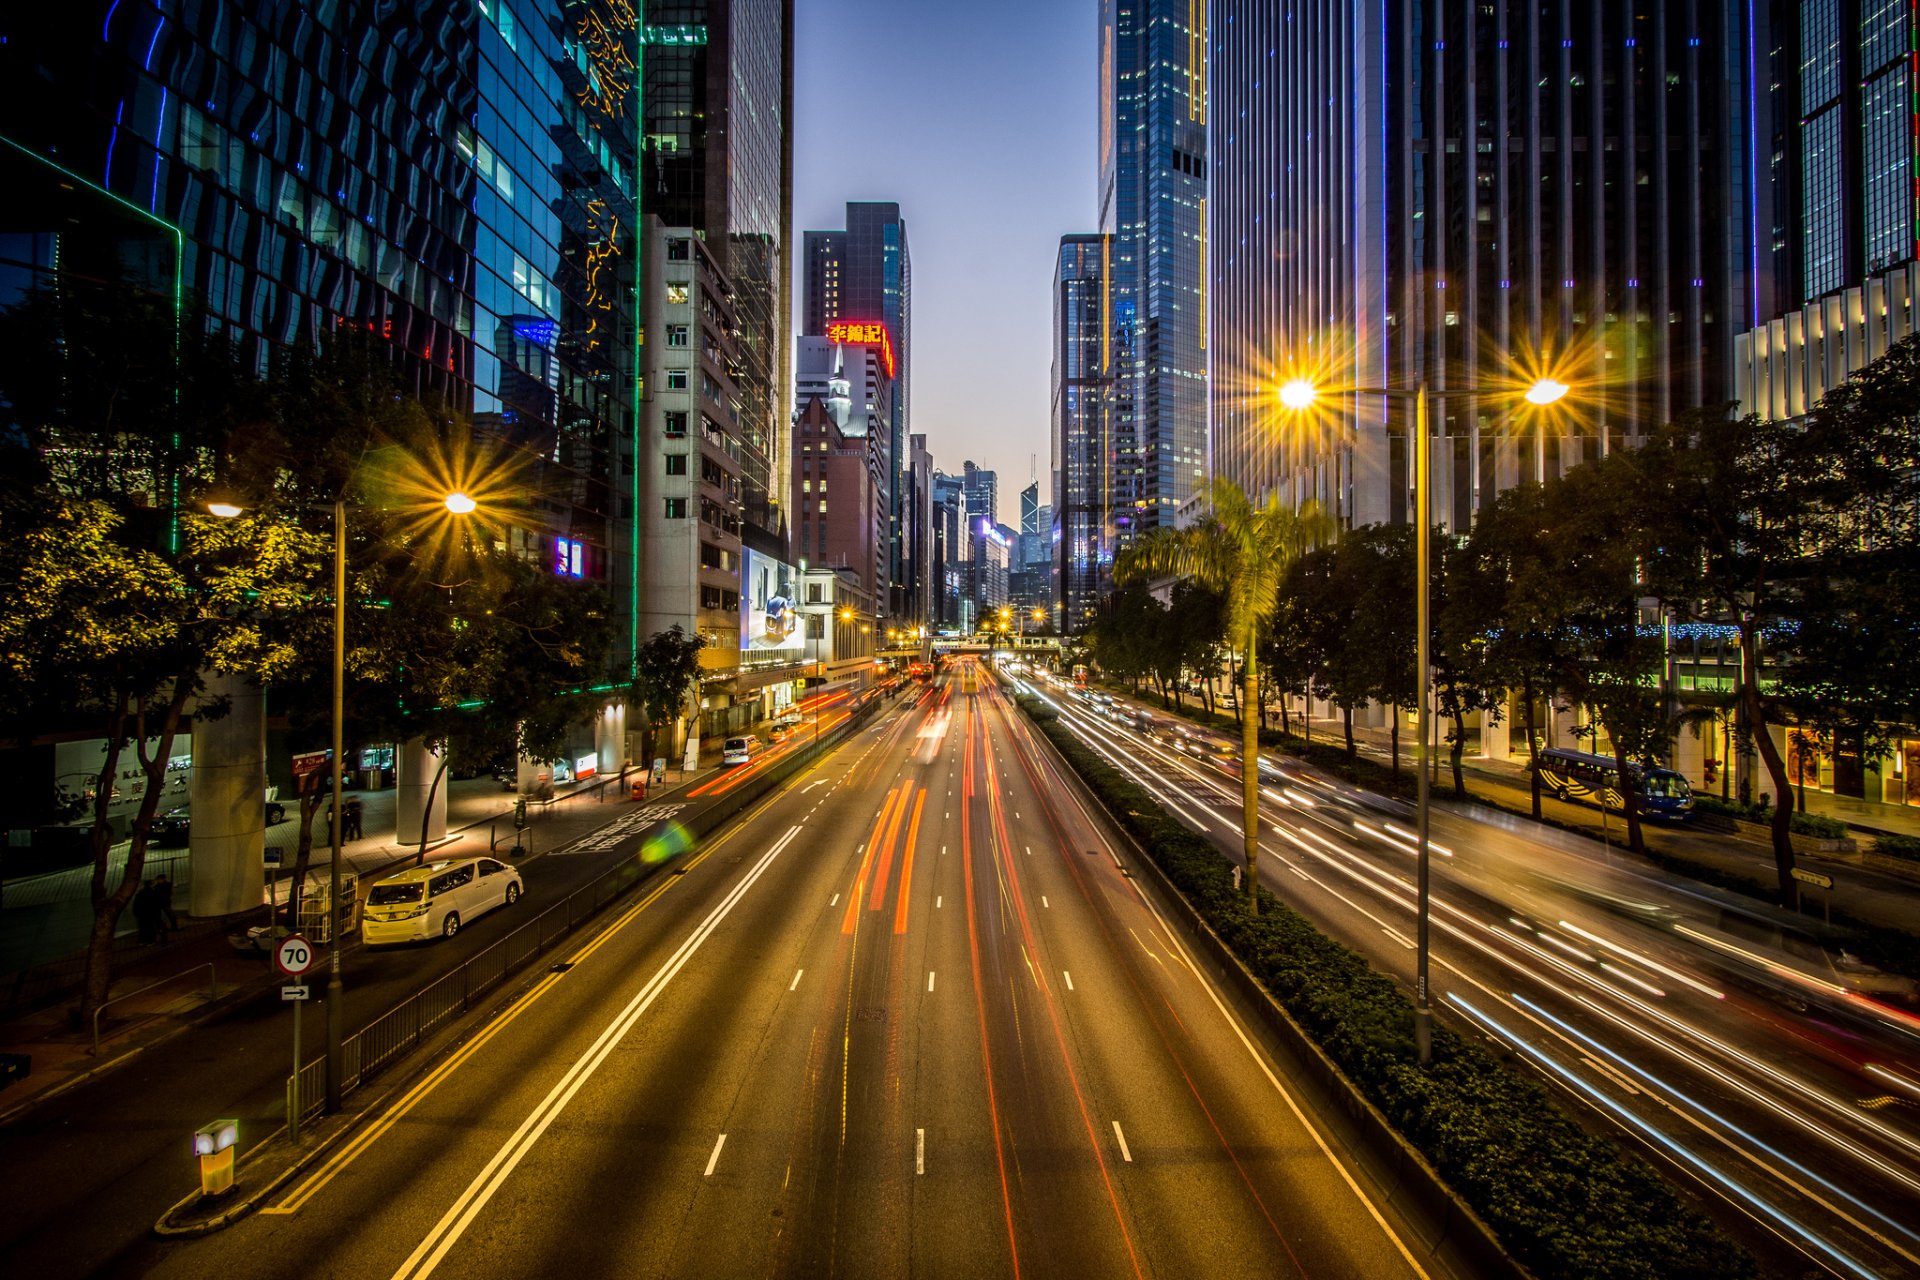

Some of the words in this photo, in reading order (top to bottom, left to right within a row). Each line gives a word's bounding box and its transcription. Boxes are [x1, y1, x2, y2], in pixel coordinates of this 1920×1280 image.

[829, 323, 881, 343] 李錦記
[284, 948, 307, 964] 70
